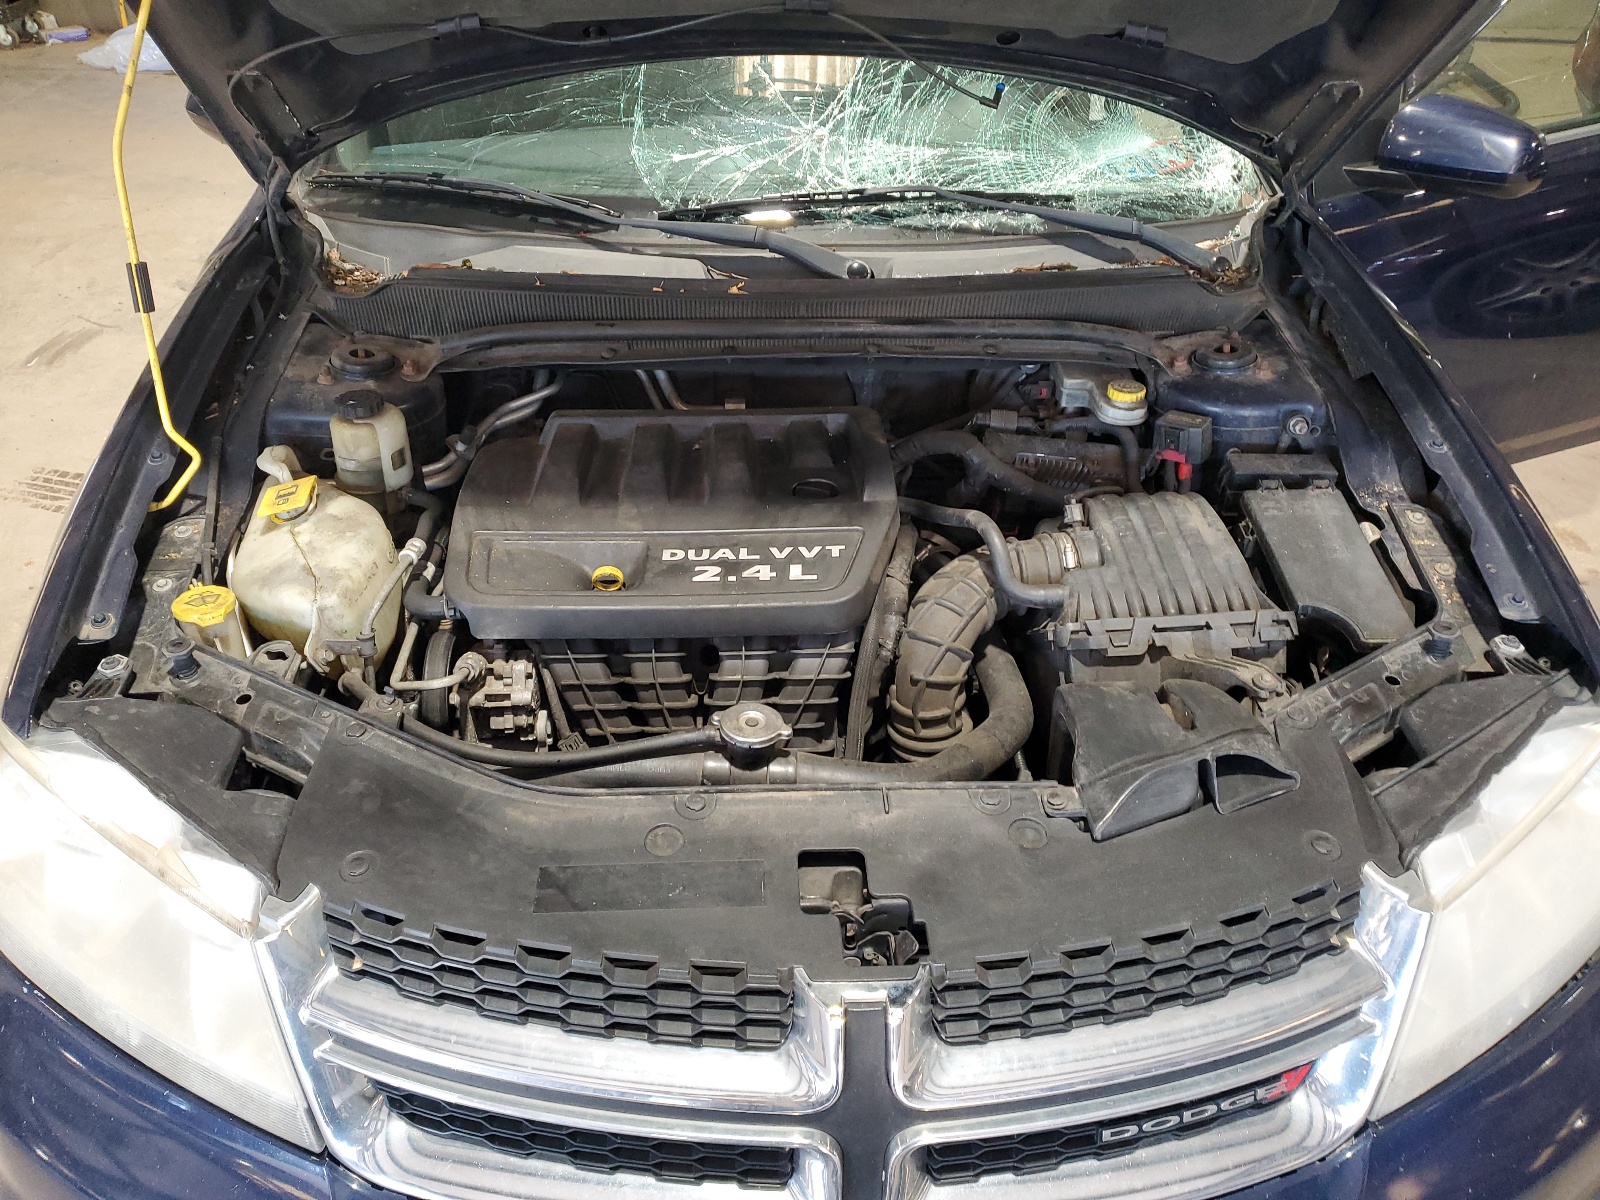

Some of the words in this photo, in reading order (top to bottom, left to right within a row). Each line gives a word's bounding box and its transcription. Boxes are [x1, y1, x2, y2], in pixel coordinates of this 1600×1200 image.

[662, 547, 760, 561] DUAL
[769, 545, 846, 559] VVT
[1102, 1080, 1286, 1142] DODGE
